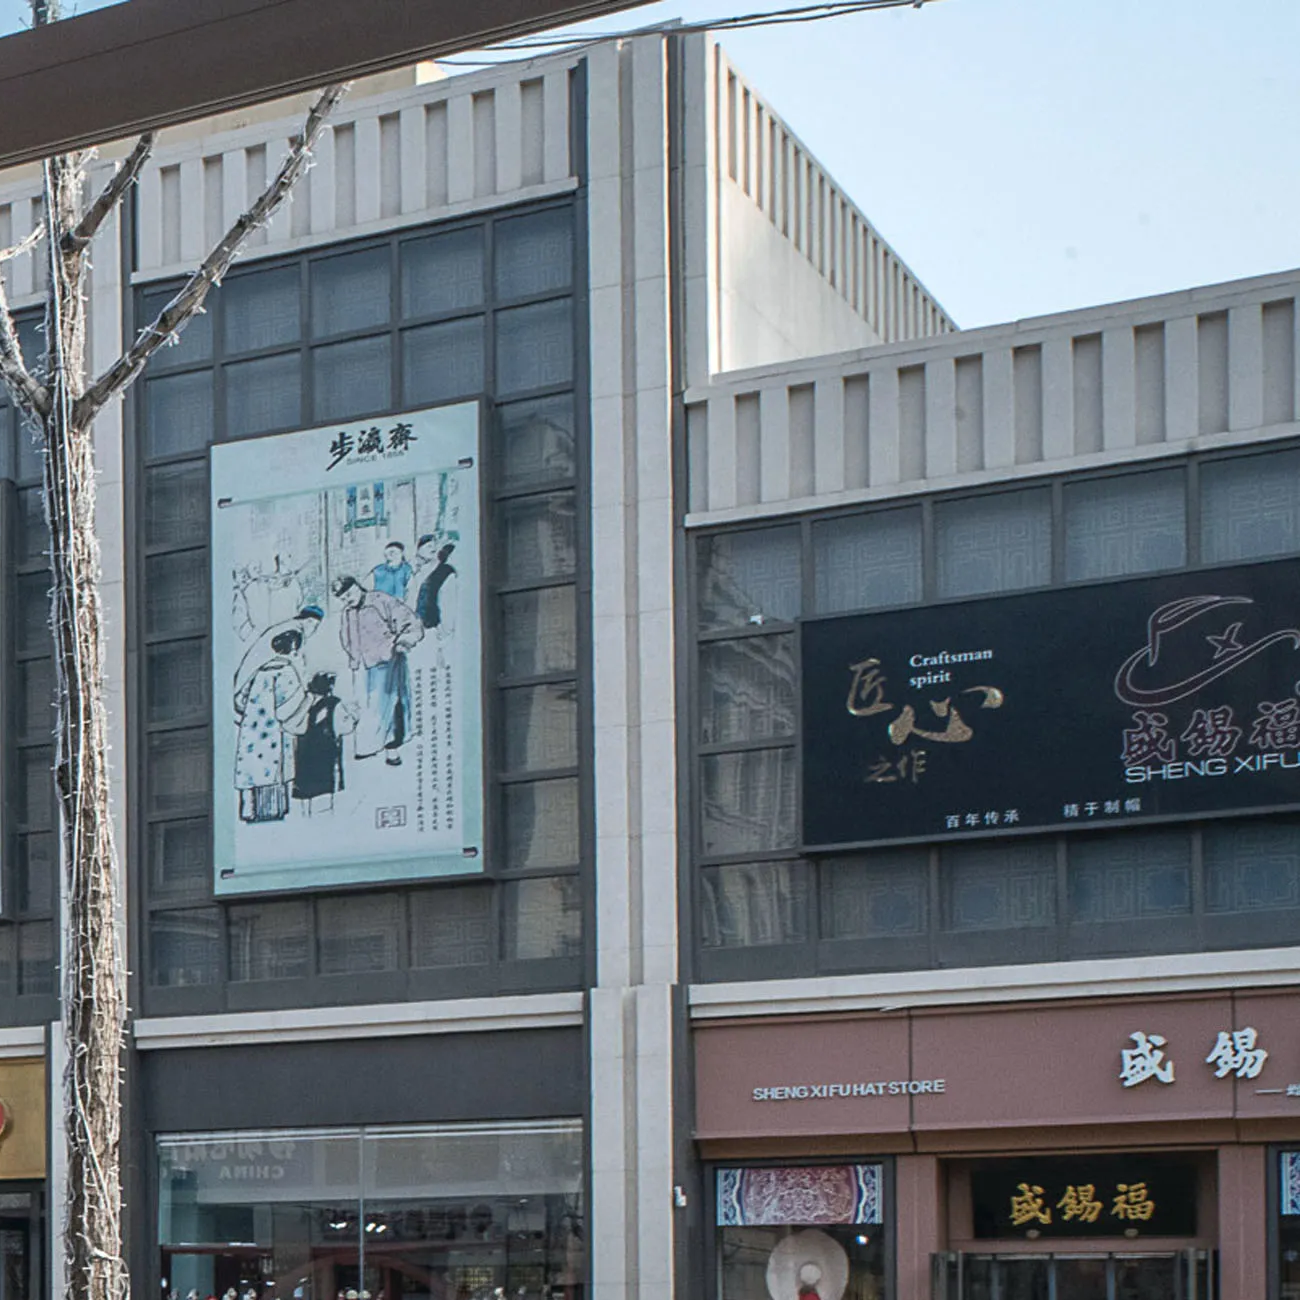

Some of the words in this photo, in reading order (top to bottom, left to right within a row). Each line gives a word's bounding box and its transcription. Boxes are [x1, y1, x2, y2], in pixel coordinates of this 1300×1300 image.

[908, 648, 993, 669] Craftsman
[908, 670, 952, 689] spirit
[1125, 756, 1228, 783] SHENG
[945, 808, 1021, 830] 百年传承
[752, 1086, 808, 1100] SHENG
[853, 1082, 886, 1096] HAT
[888, 1079, 946, 1095] STORE
